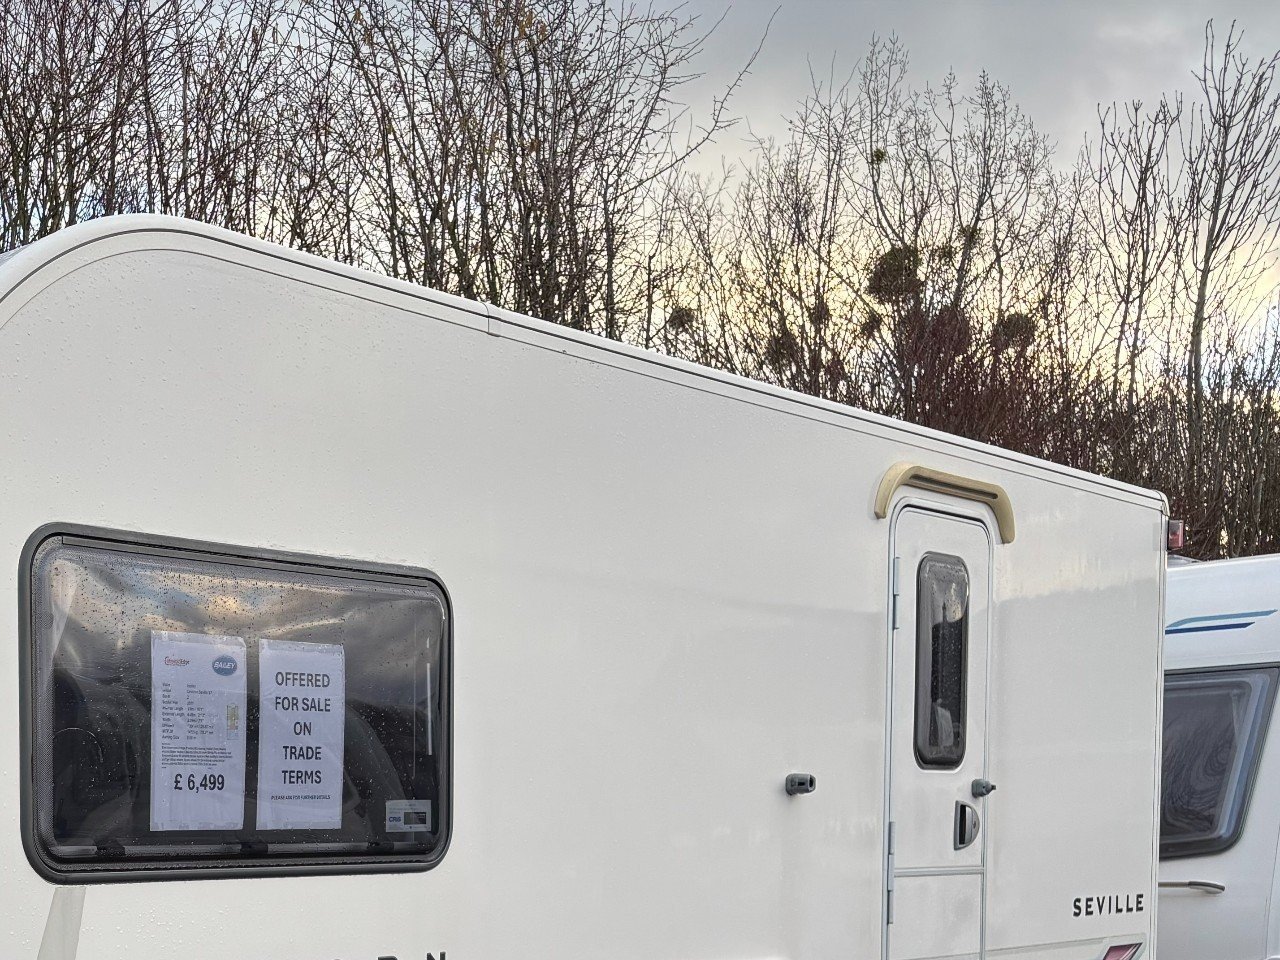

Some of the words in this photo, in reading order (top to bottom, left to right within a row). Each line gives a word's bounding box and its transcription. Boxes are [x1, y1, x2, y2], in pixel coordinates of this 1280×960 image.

[213, 661, 236, 669] BAILEY
[275, 672, 331, 688] OFFERED
[275, 696, 299, 711] FOR
[301, 698, 331, 712] SALE
[293, 721, 312, 736] ON
[283, 746, 322, 760] TRADE
[174, 773, 183, 791] £
[187, 773, 225, 794] 6,499
[282, 769, 322, 785] TERMS
[1073, 894, 1144, 917] SEVILLE
